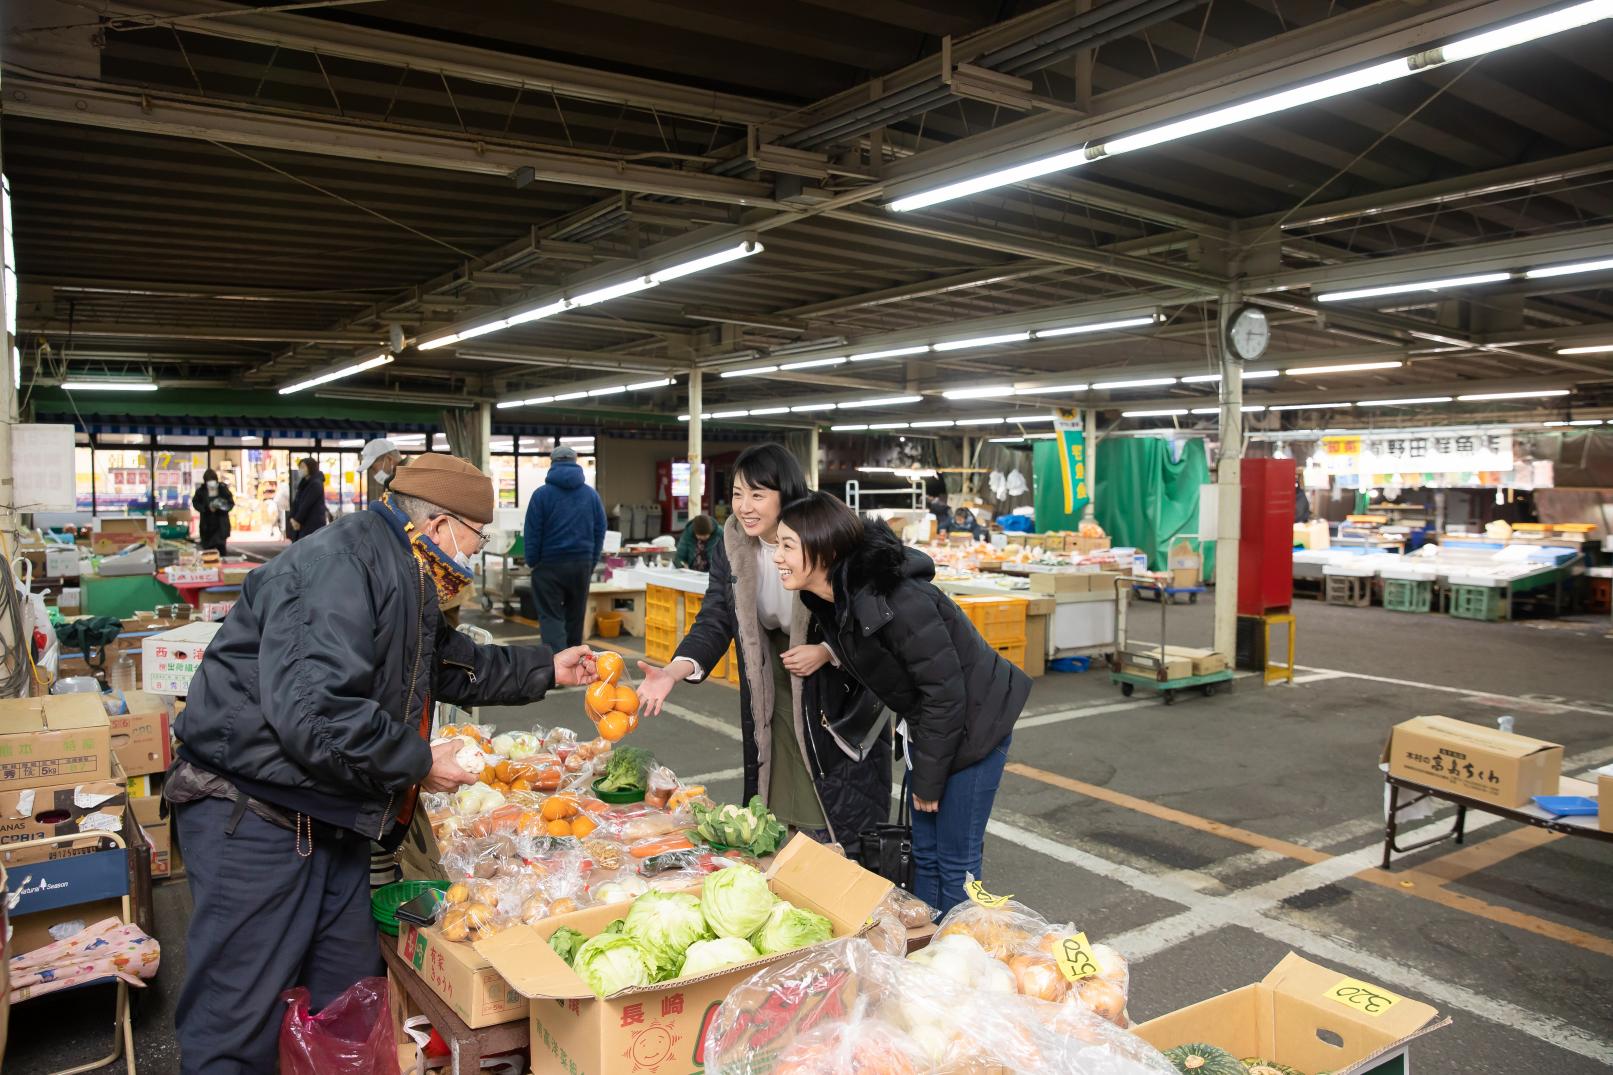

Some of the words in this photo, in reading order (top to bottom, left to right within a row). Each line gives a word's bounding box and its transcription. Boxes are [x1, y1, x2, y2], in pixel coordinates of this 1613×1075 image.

[1062, 938, 1097, 978] 550
[620, 993, 685, 1027] 長崎
[1336, 986, 1393, 1013] 320
